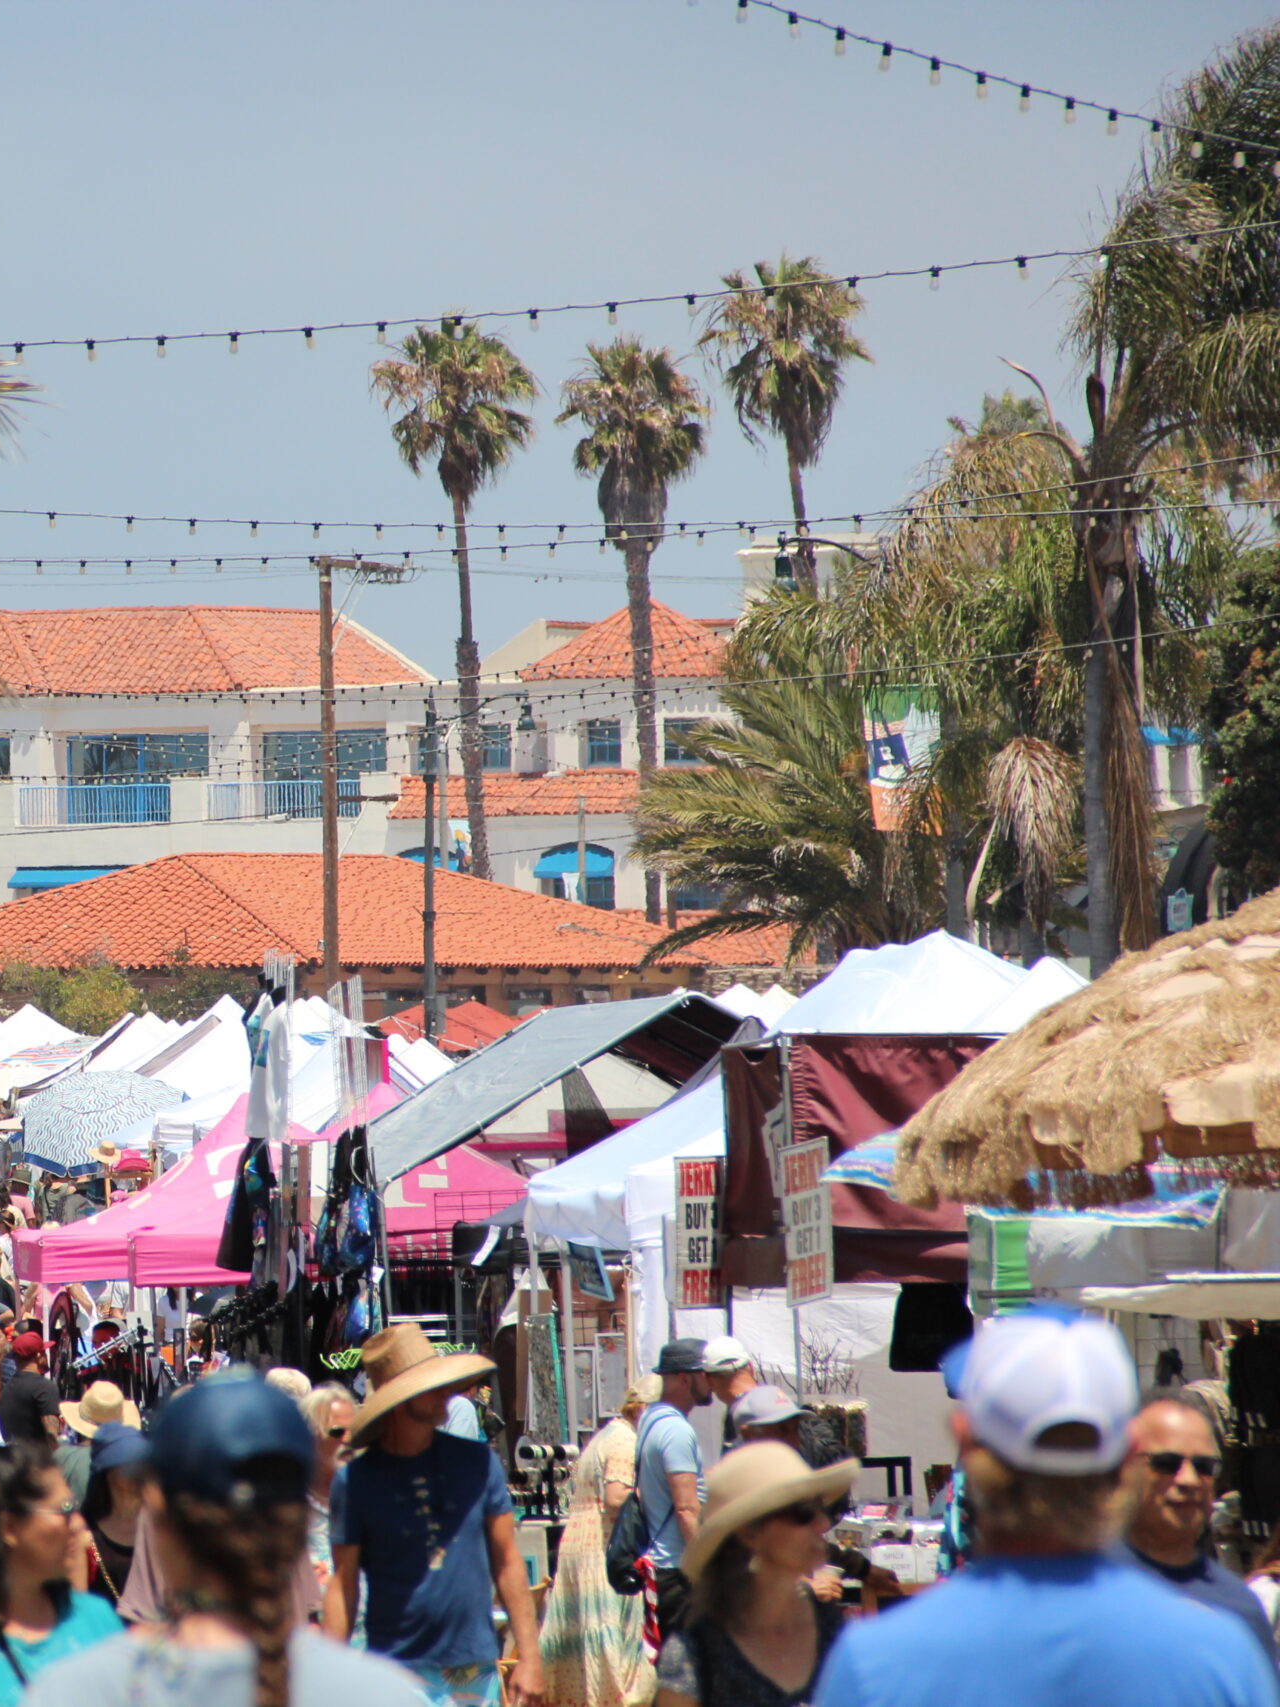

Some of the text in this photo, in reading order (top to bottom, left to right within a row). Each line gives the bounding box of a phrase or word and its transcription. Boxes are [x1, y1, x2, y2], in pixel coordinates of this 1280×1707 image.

[685, 1201, 718, 1230] BUY 3
[792, 1193, 821, 1226] BUY 3
[688, 1236, 717, 1264] GET 1
[796, 1224, 821, 1255] GET 1
